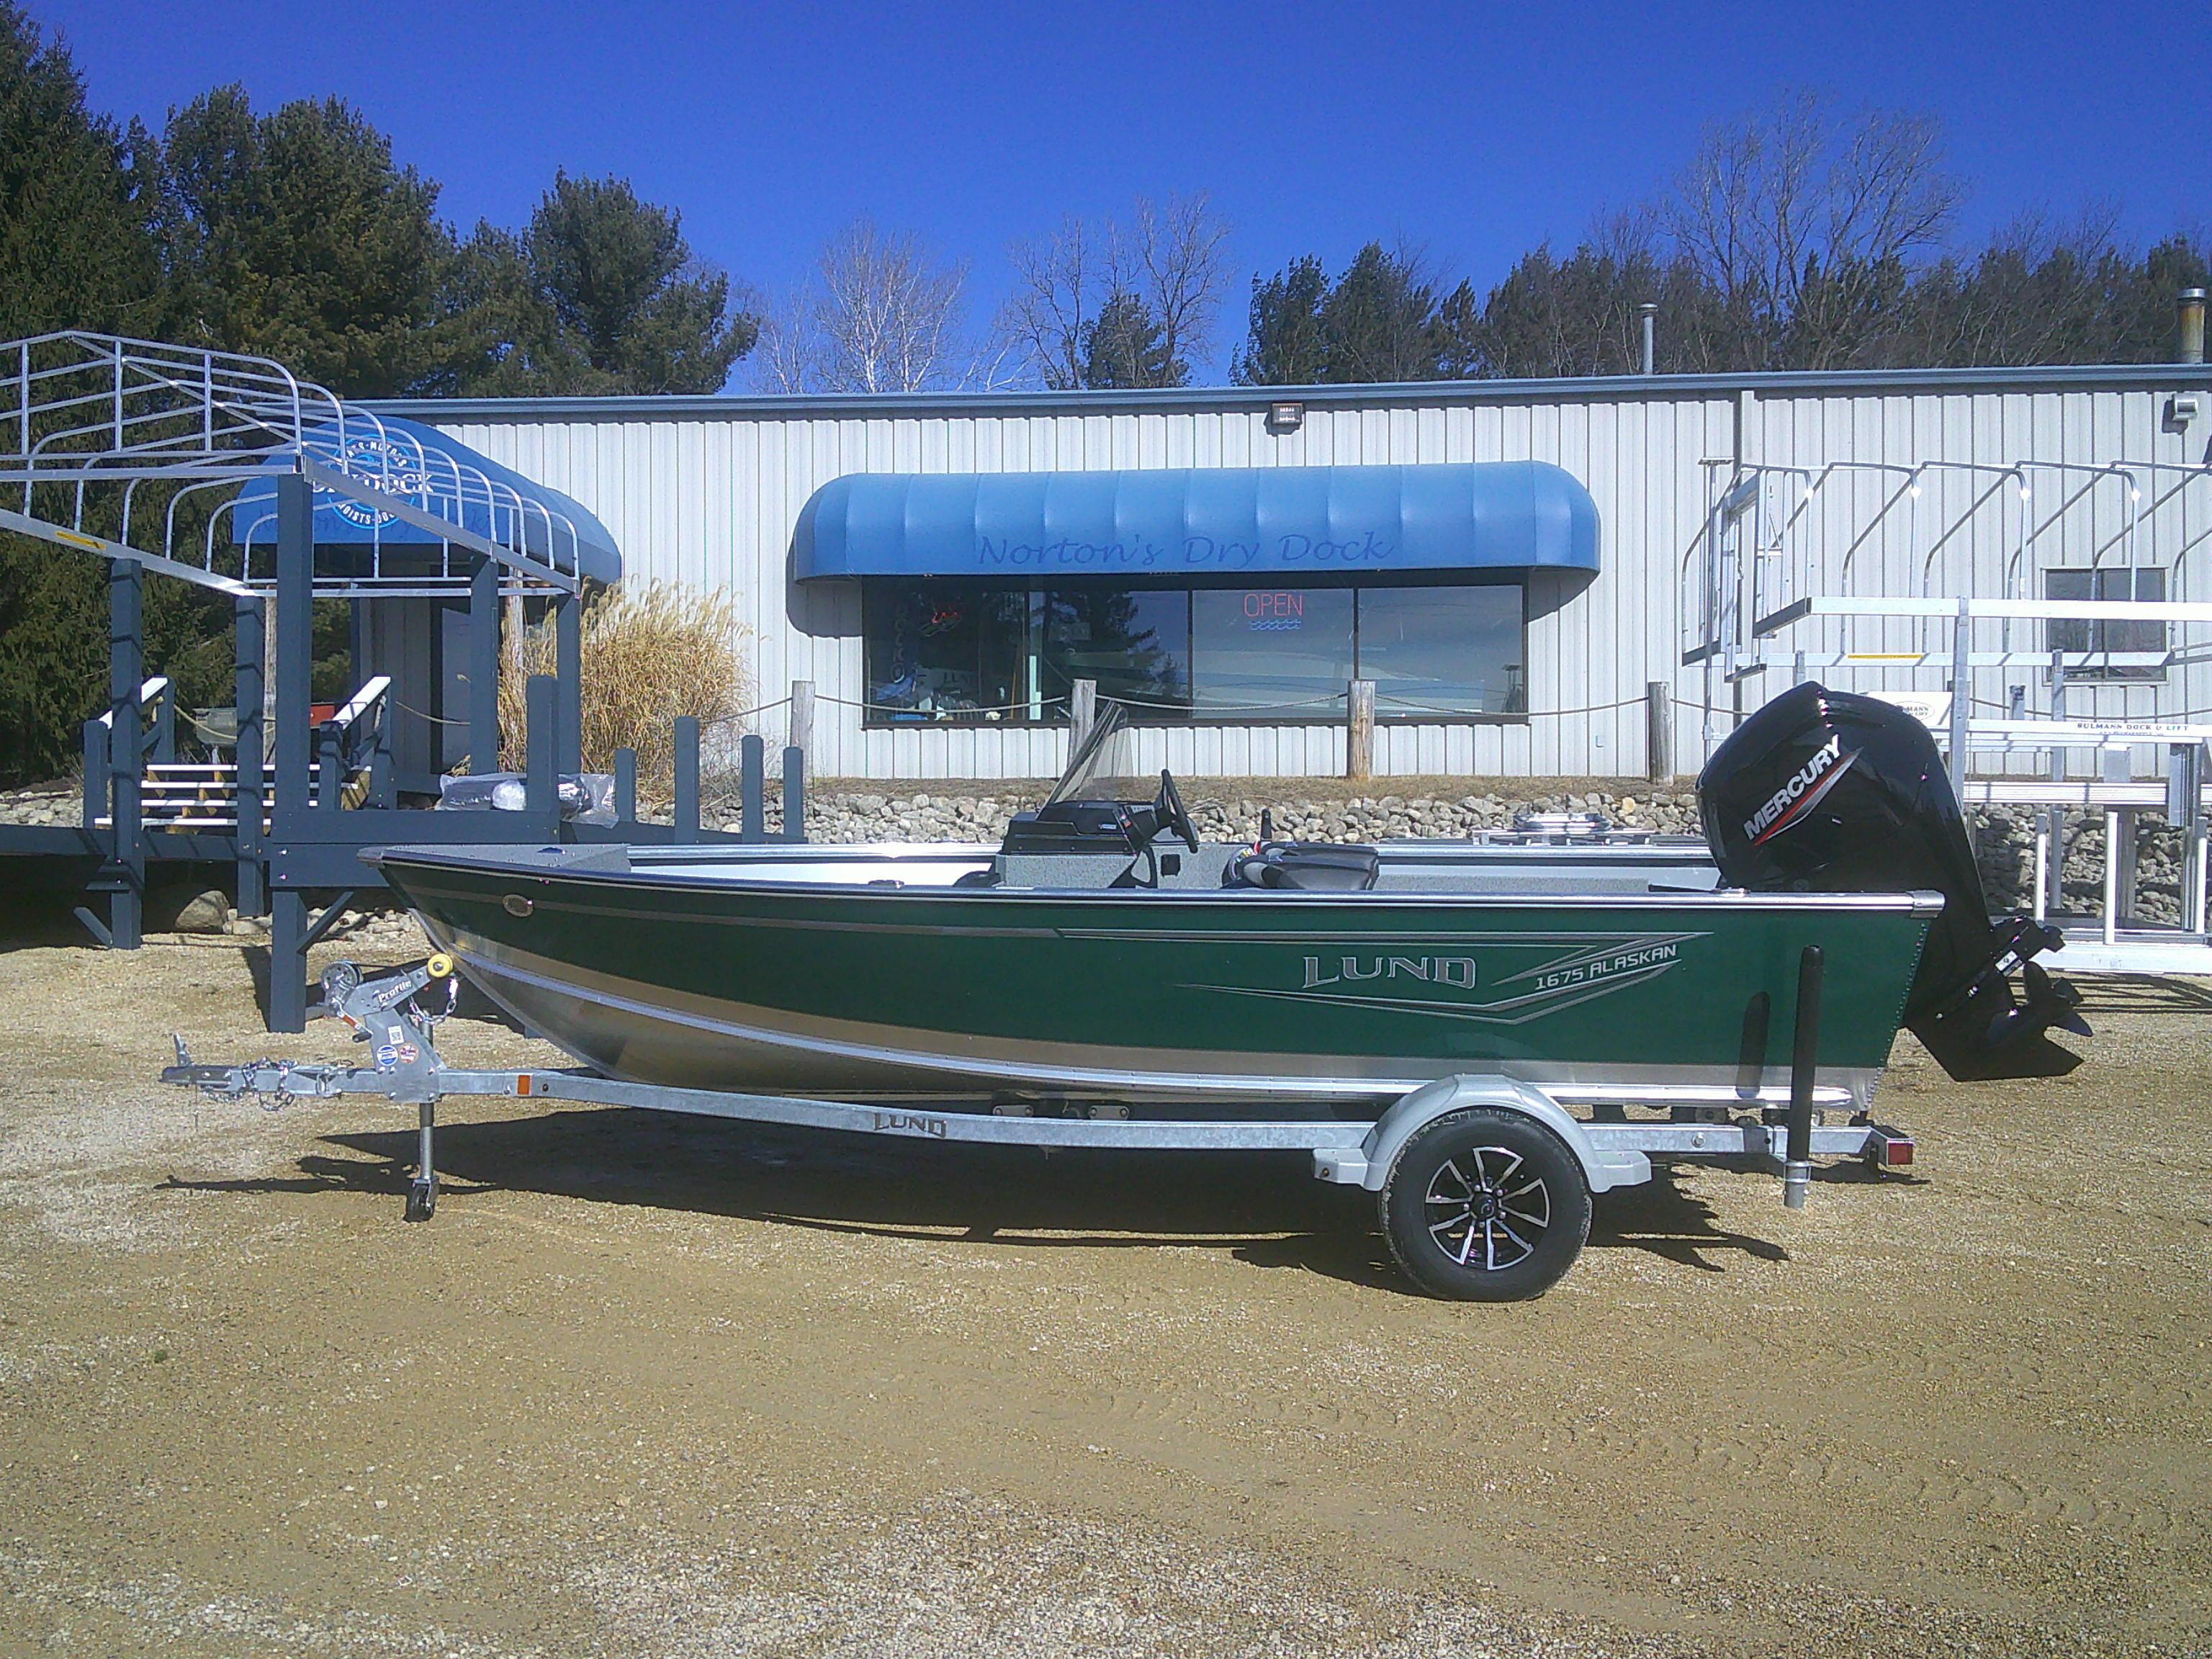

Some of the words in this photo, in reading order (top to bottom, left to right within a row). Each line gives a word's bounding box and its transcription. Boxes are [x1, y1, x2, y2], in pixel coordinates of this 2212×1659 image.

[979, 534, 1164, 565] Norton's
[1182, 536, 1260, 570] Dry
[1278, 531, 1395, 562] Dock
[1244, 593, 1303, 617] OPEN
[1743, 734, 1840, 840] MERCURY
[1303, 956, 1476, 989] LUND
[1534, 967, 1584, 991] 1675
[1589, 944, 1677, 979] ALASKAN
[873, 1112, 947, 1138] LUND
